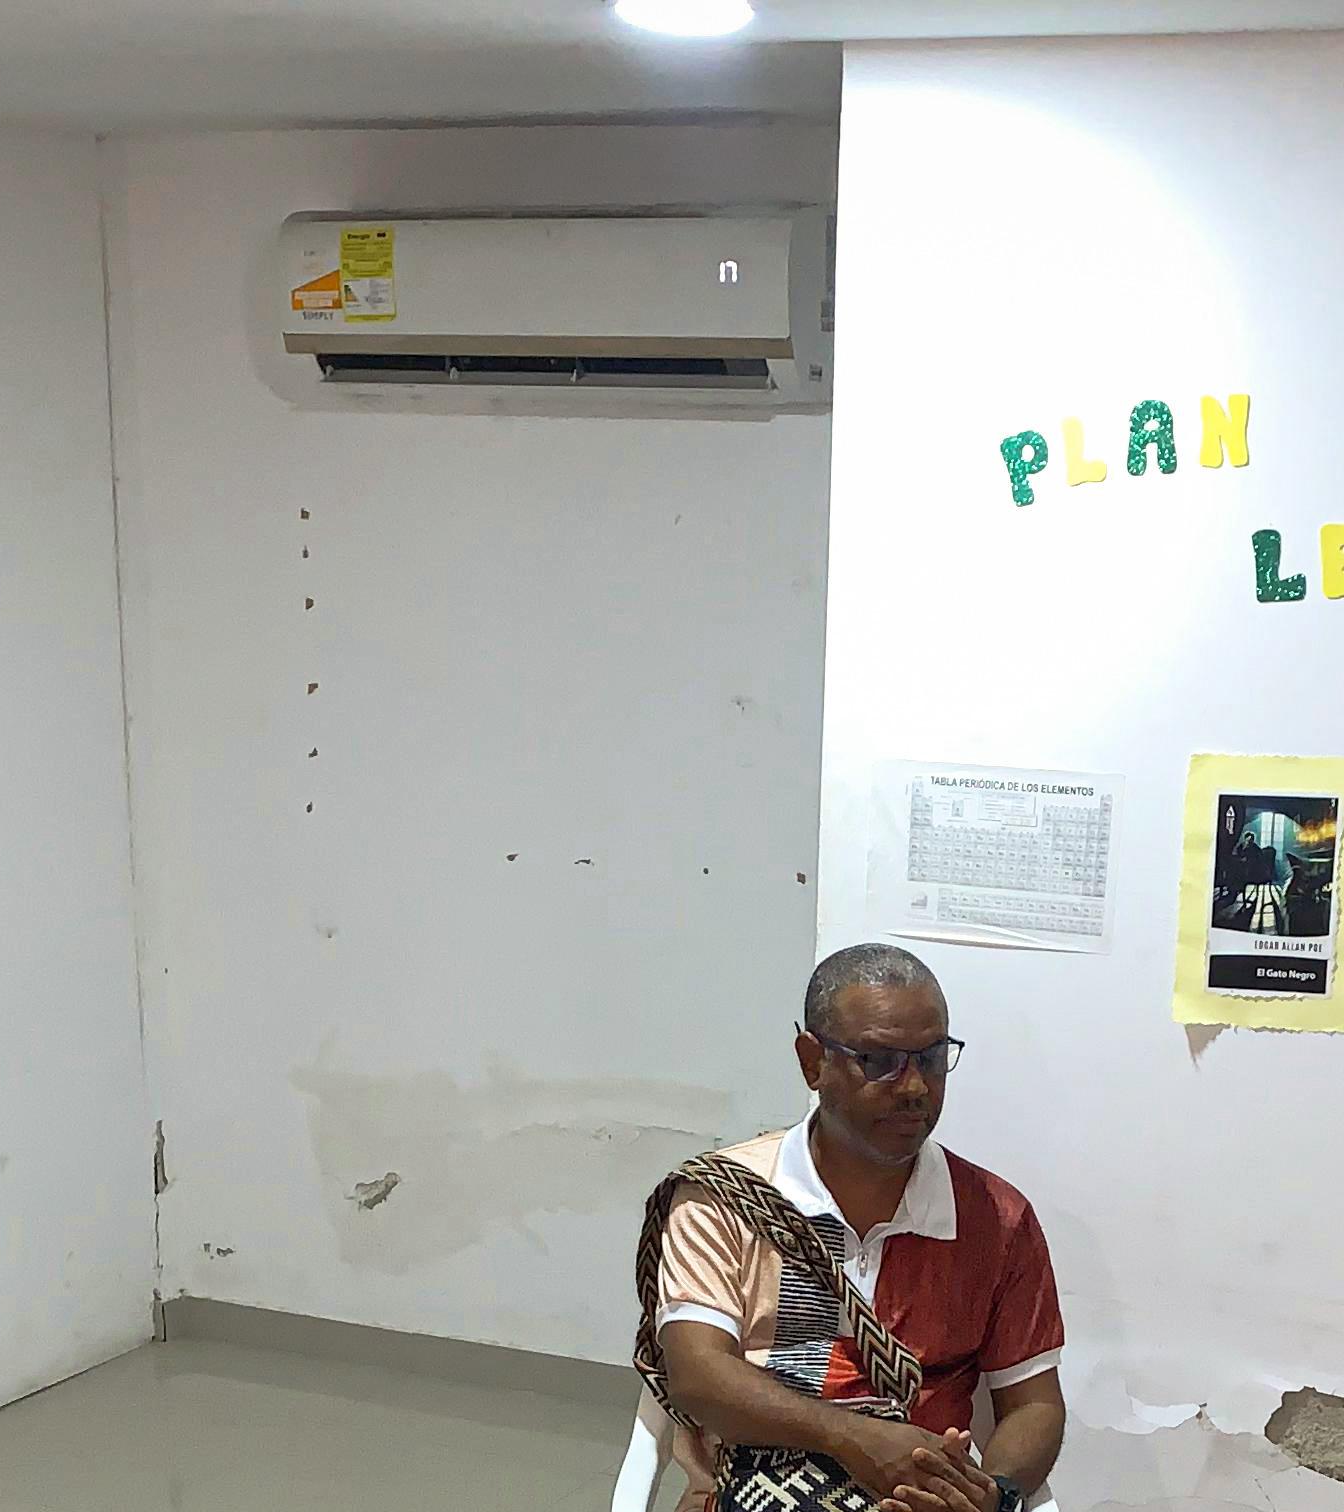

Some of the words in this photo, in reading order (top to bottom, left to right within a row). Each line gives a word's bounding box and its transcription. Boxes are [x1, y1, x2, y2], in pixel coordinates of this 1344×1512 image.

[1000, 394, 1251, 506] PLAN
[930, 776, 958, 788] TABLA
[959, 777, 1006, 792] PERIÓDICA
[1007, 782, 1019, 792] DE
[1021, 783, 1039, 793] LOS
[1040, 784, 1094, 797] ELEMENTOS
[1256, 968, 1265, 977] El
[1266, 968, 1288, 979] Gato
[1288, 970, 1316, 981] Negro
